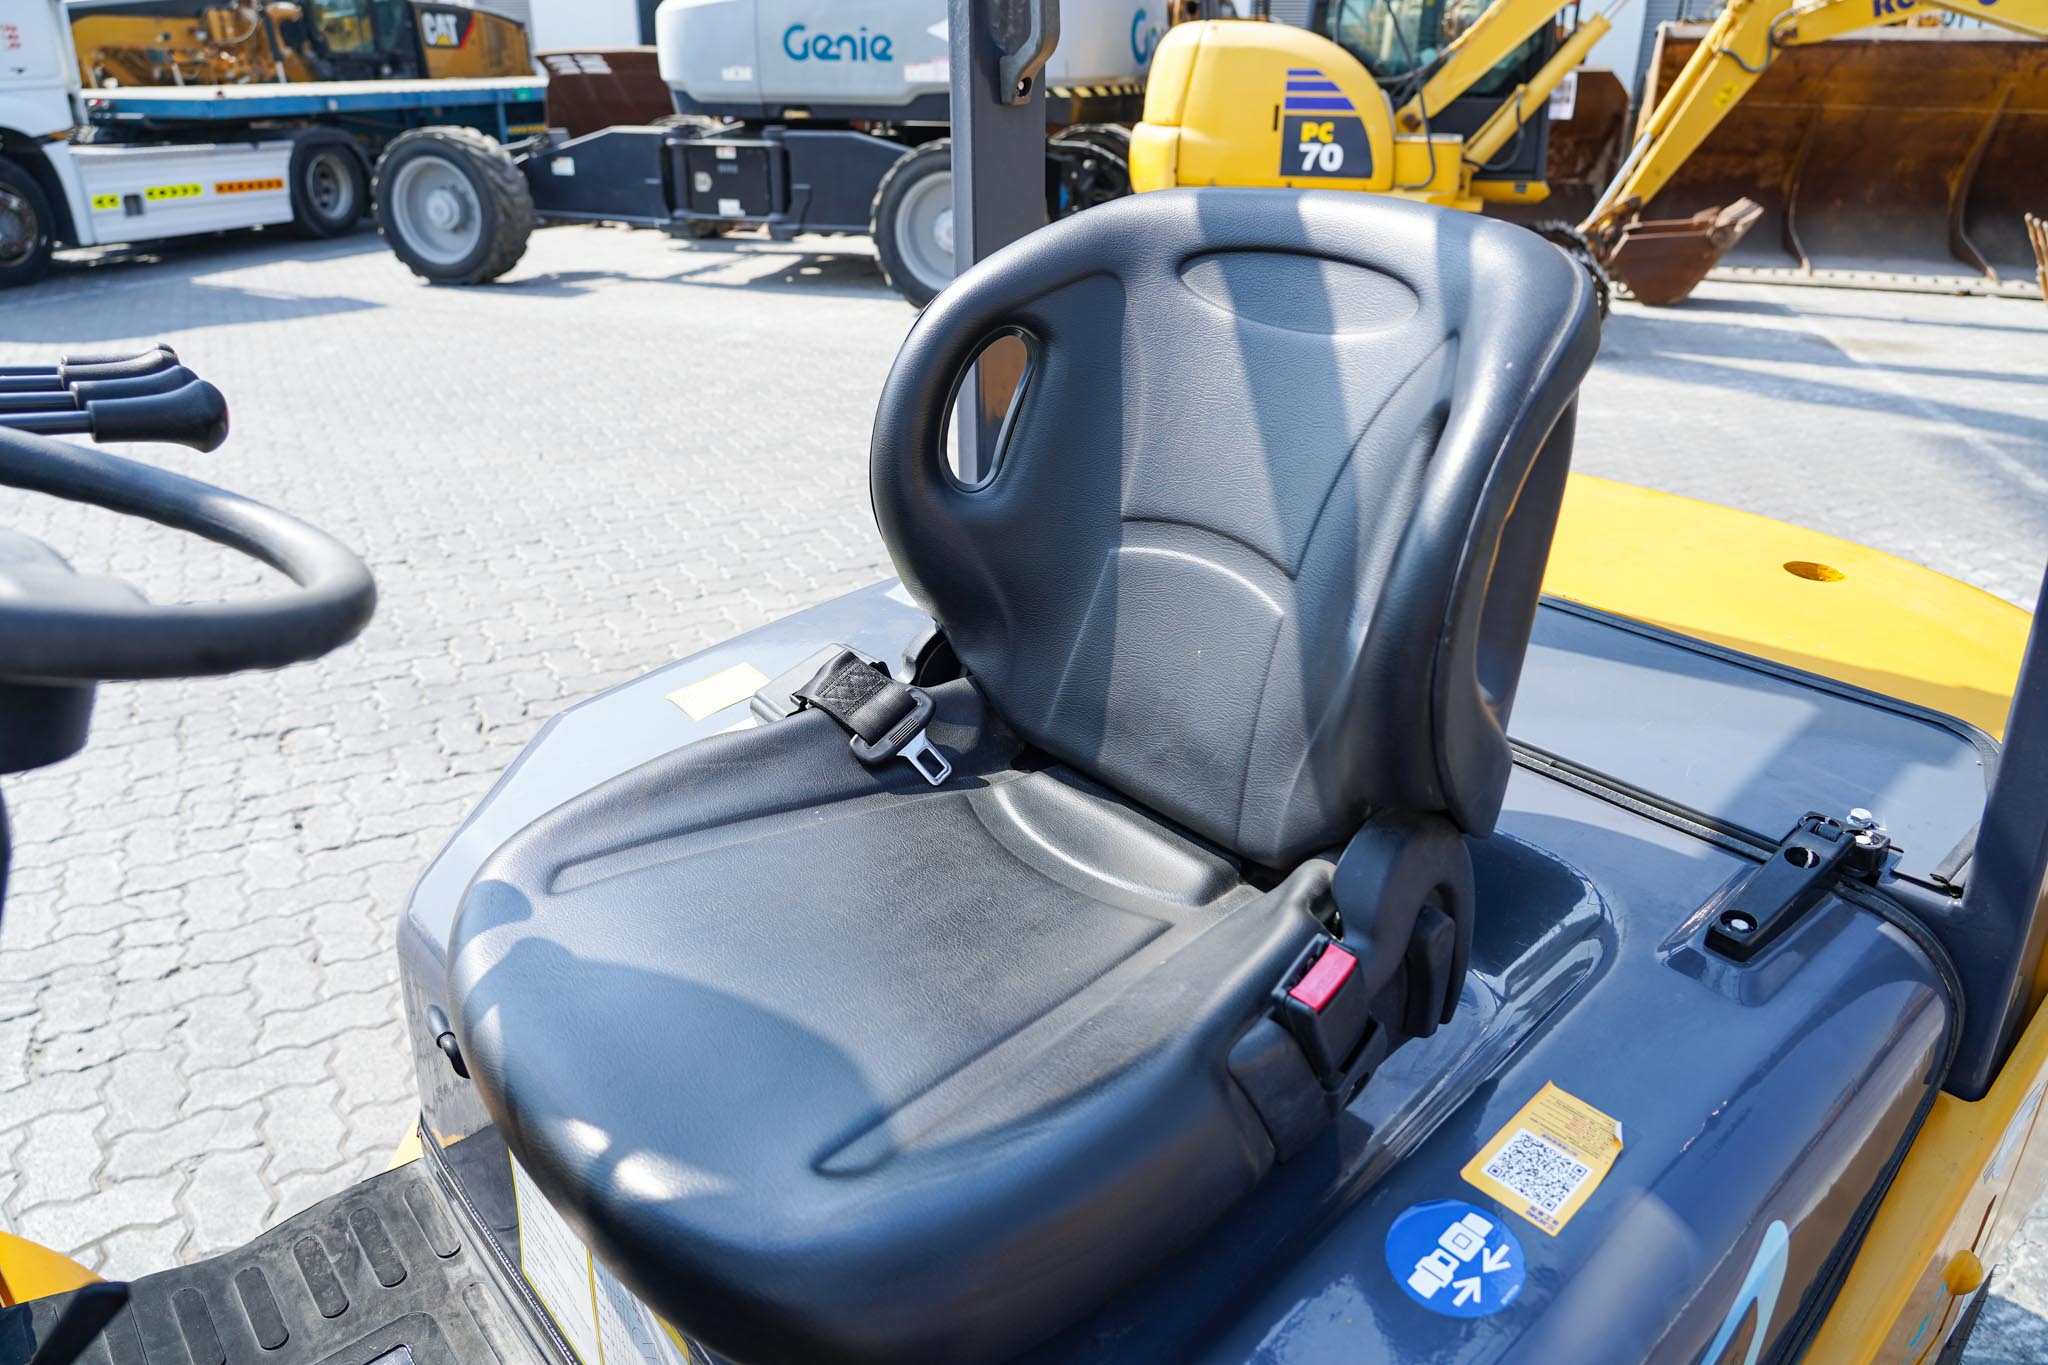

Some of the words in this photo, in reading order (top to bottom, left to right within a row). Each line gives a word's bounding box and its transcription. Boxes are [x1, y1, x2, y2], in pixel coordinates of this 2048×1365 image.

[421, 12, 459, 46] CAT
[783, 25, 893, 61] Genie
[1301, 121, 1336, 143] PC
[1299, 142, 1344, 172] 70
